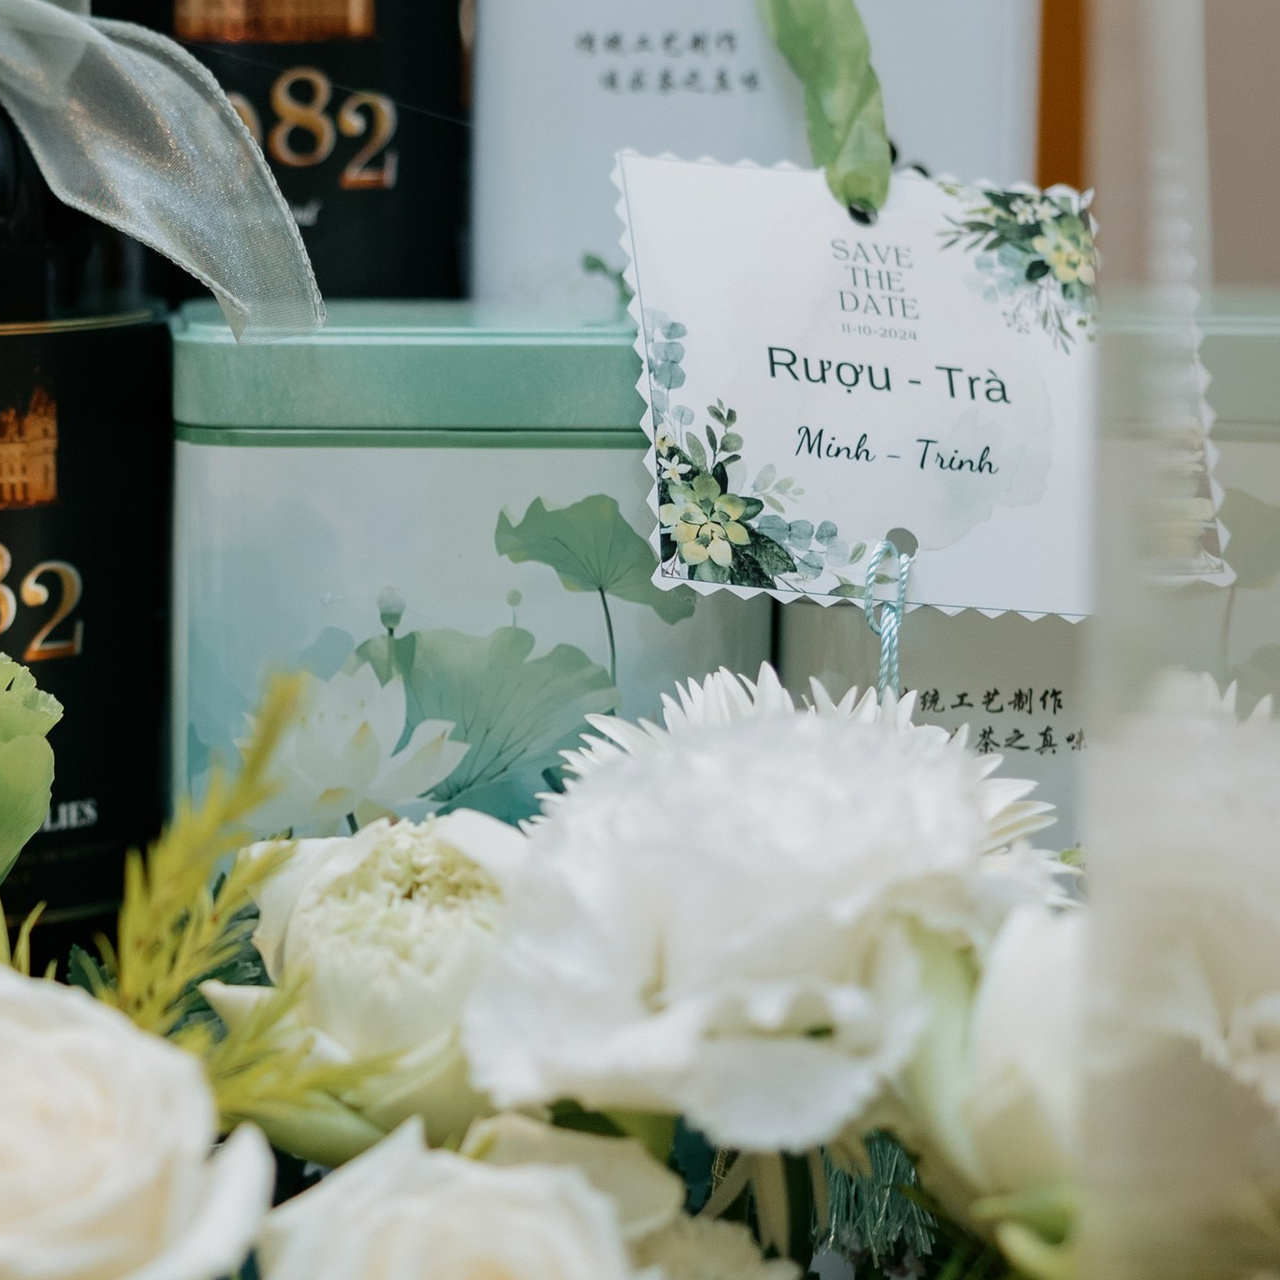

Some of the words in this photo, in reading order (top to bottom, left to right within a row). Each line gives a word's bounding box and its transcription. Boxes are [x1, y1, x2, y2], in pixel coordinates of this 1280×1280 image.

[228, 67, 399, 190] 82
[830, 238, 913, 269] SAVE
[844, 265, 905, 293] THE
[839, 290, 920, 320] DATE
[767, 346, 892, 394] Rượu
[935, 365, 1011, 404] Trà
[795, 425, 876, 462] Minh
[916, 439, 999, 474] Trinh
[899, 687, 1063, 716] 统工艺制作
[948, 724, 1088, 754] 茶之真味
